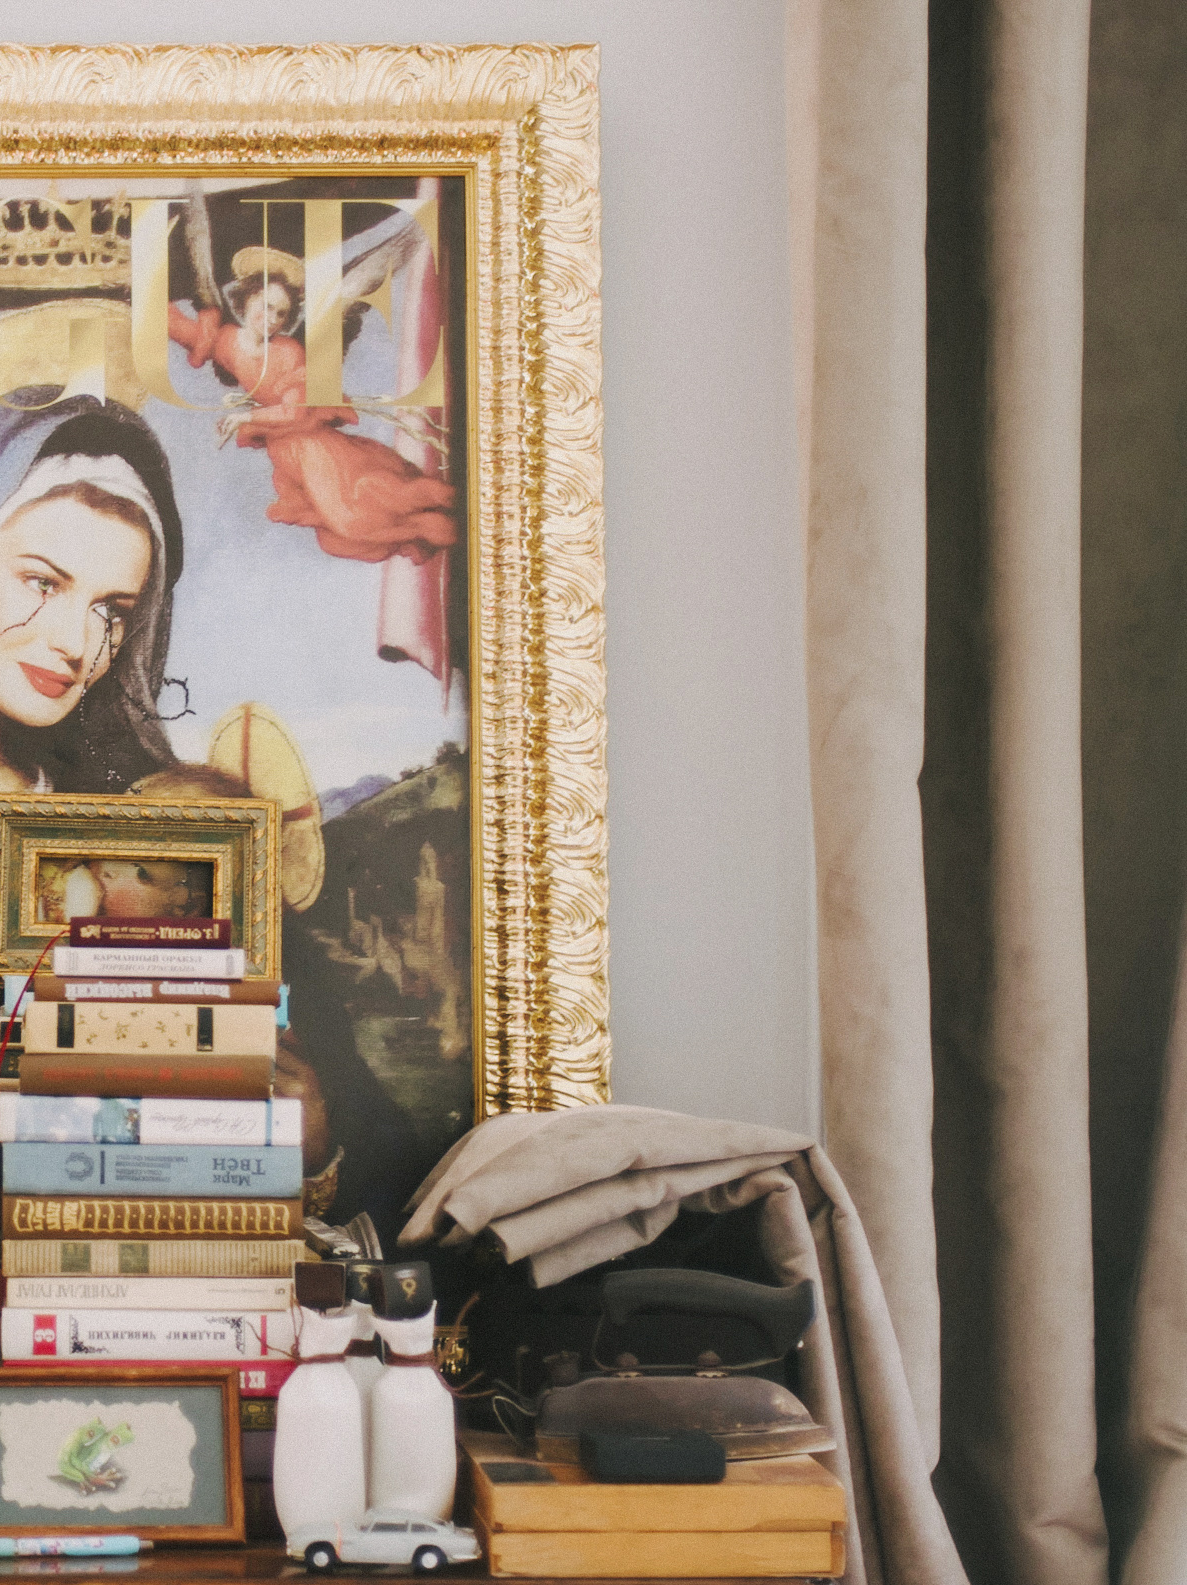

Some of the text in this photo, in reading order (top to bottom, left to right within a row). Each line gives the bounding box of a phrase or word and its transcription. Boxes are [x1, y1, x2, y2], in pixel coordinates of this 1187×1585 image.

[212, 1158, 266, 1175] Твен
[212, 1173, 251, 1187] Марк
[87, 1330, 157, 1341] ЧИВИЛИХИН
[165, 1330, 226, 1341] ВЛАДИМИР
